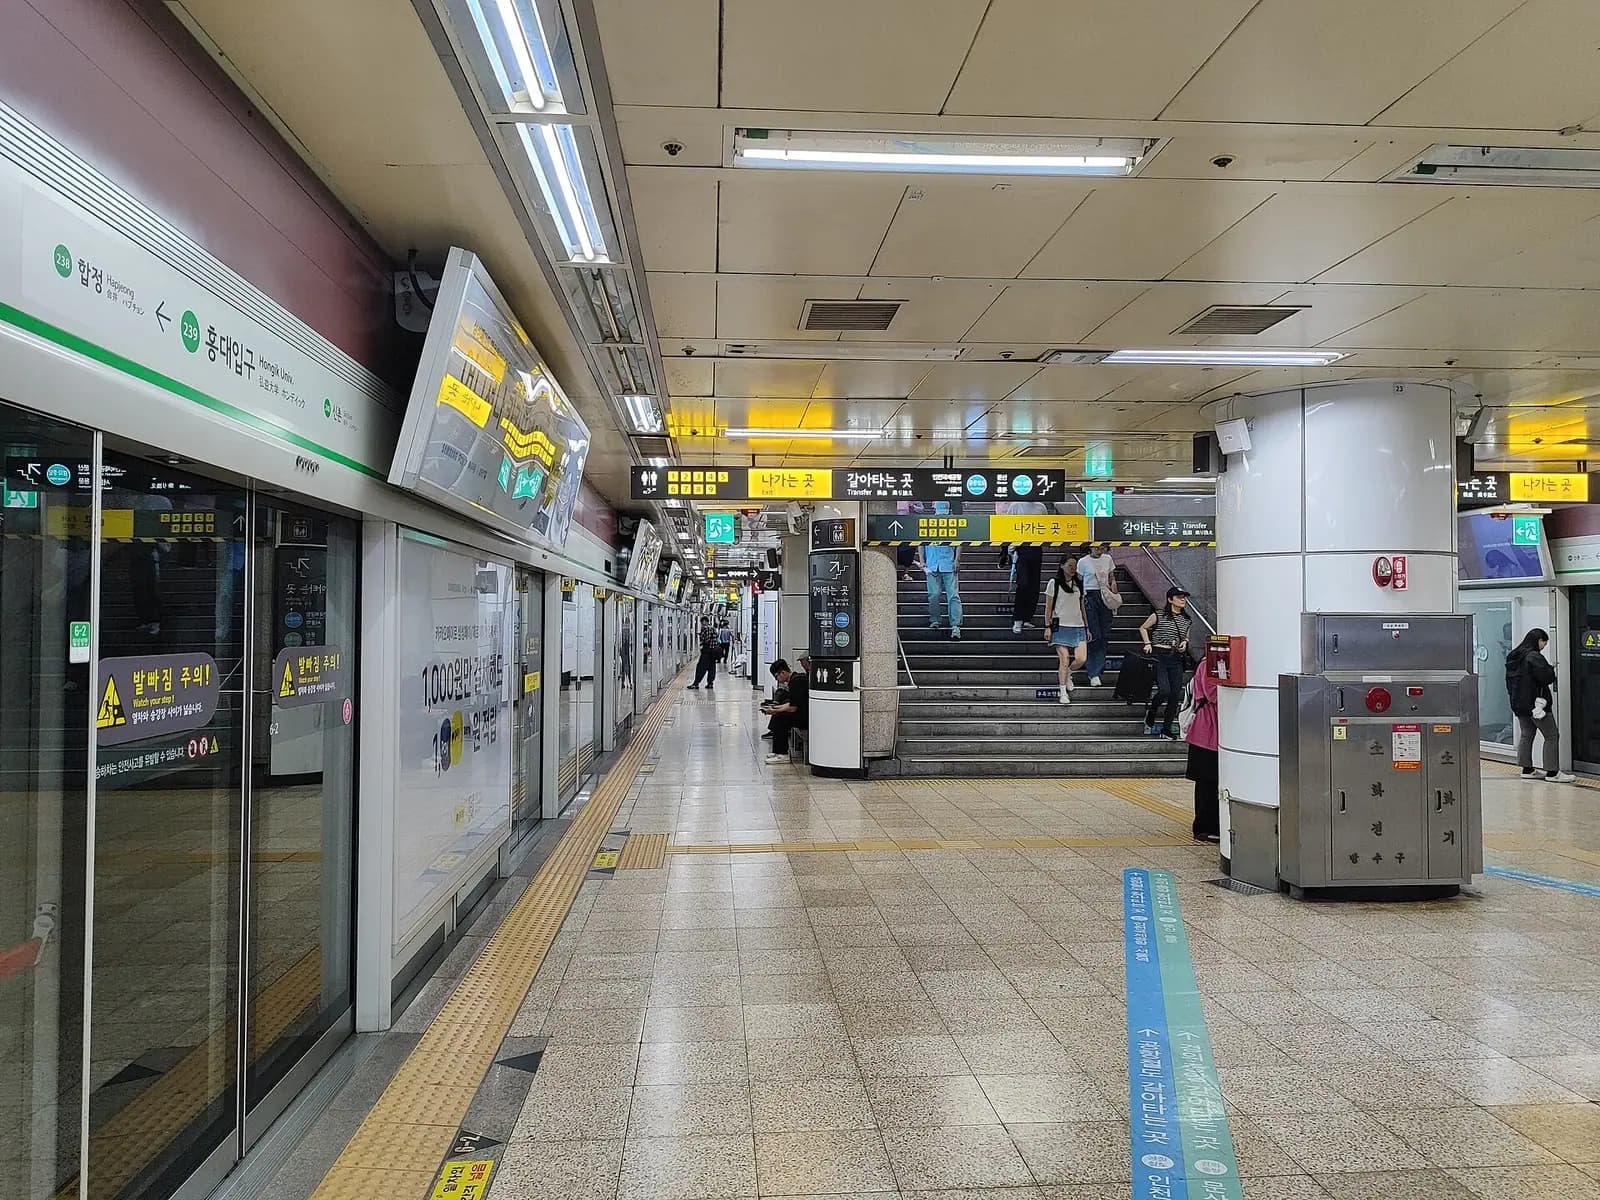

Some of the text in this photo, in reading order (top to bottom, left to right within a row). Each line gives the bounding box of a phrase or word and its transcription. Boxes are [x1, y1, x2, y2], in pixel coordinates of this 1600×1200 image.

[56, 253, 70, 269] 238
[77, 258, 103, 294] 합정
[106, 274, 135, 301] Hapjeong
[183, 322, 198, 341] 239
[205, 324, 256, 381] 홍대입구
[259, 354, 295, 386] Hongik Univ.
[761, 473, 815, 488] 나가는 곳
[847, 472, 914, 489] 갈아타는 곳
[1484, 475, 1498, 491] 곳
[1523, 477, 1572, 492] 나가는 곳
[847, 488, 872, 496] Transfer
[1014, 521, 1061, 536] 나가는 곳
[1122, 521, 1179, 536] 갈아타는 곳
[1182, 521, 1207, 530] Transfer
[812, 585, 849, 597] 갈아타는 곳
[74, 625, 87, 637] 6-2
[298, 653, 340, 675] 발빠짐 주의!
[133, 663, 211, 696] 발빠짐 주의!
[421, 656, 473, 714] 1,000원만
[132, 699, 149, 709] Watch
[149, 697, 161, 708] your
[131, 711, 149, 725] 열차와
[150, 708, 166, 722] 승강장
[167, 705, 183, 718] 사이가
[270, 722, 279, 736] 6-2
[118, 757, 144, 774] 안전사고를
[160, 752, 166, 762] 수
[1141, 1081, 1169, 1127] 갈아타는
[454, 1135, 482, 1154] 6-2
[1142, 1130, 1171, 1145] 곳
[1193, 1133, 1221, 1151] 곳
[467, 1163, 487, 1182] 넓음
